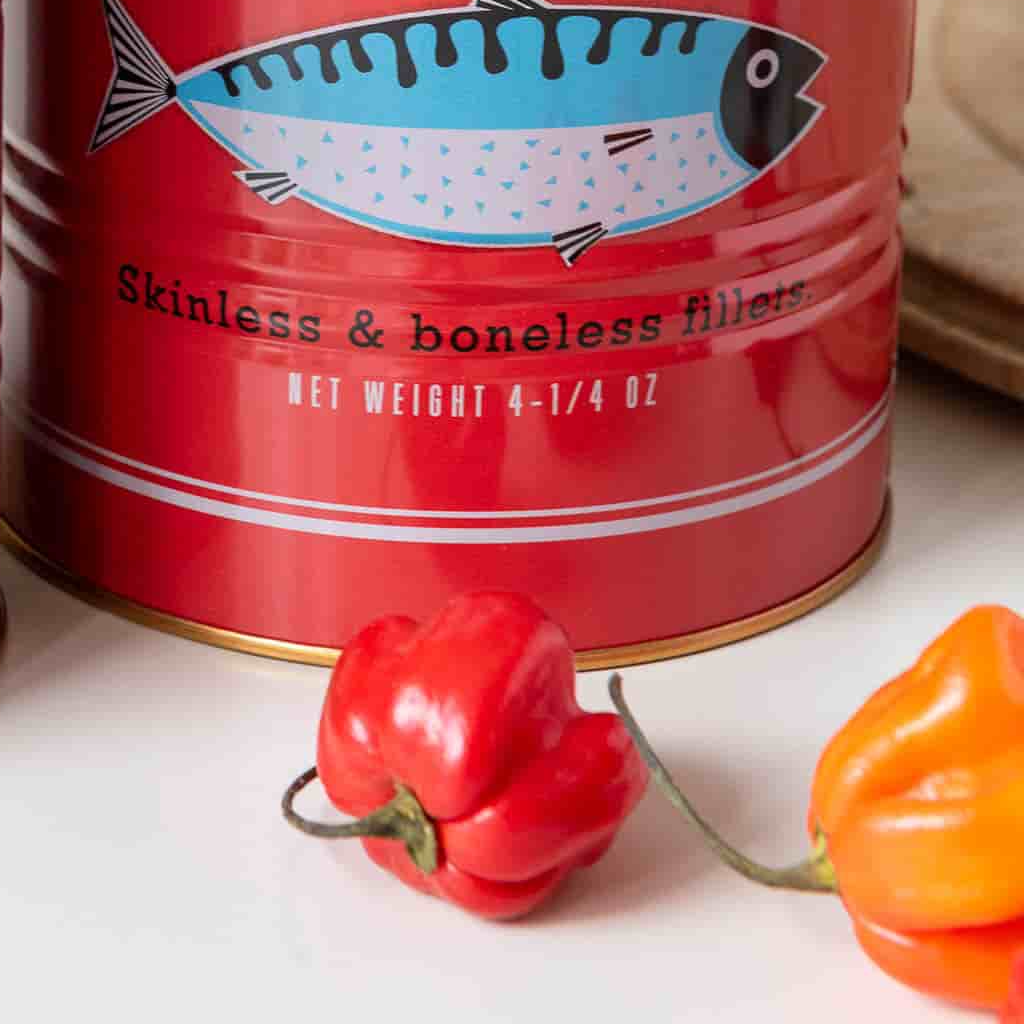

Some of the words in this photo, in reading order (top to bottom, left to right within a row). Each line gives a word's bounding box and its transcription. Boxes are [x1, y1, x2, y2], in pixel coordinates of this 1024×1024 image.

[117, 263, 323, 345] Skinless
[347, 308, 386, 350] &
[410, 308, 663, 354] boneless
[288, 372, 342, 411] NET
[364, 380, 487, 419] WEIGHT
[507, 376, 604, 418] 4-1/4
[624, 373, 659, 409] OZ
